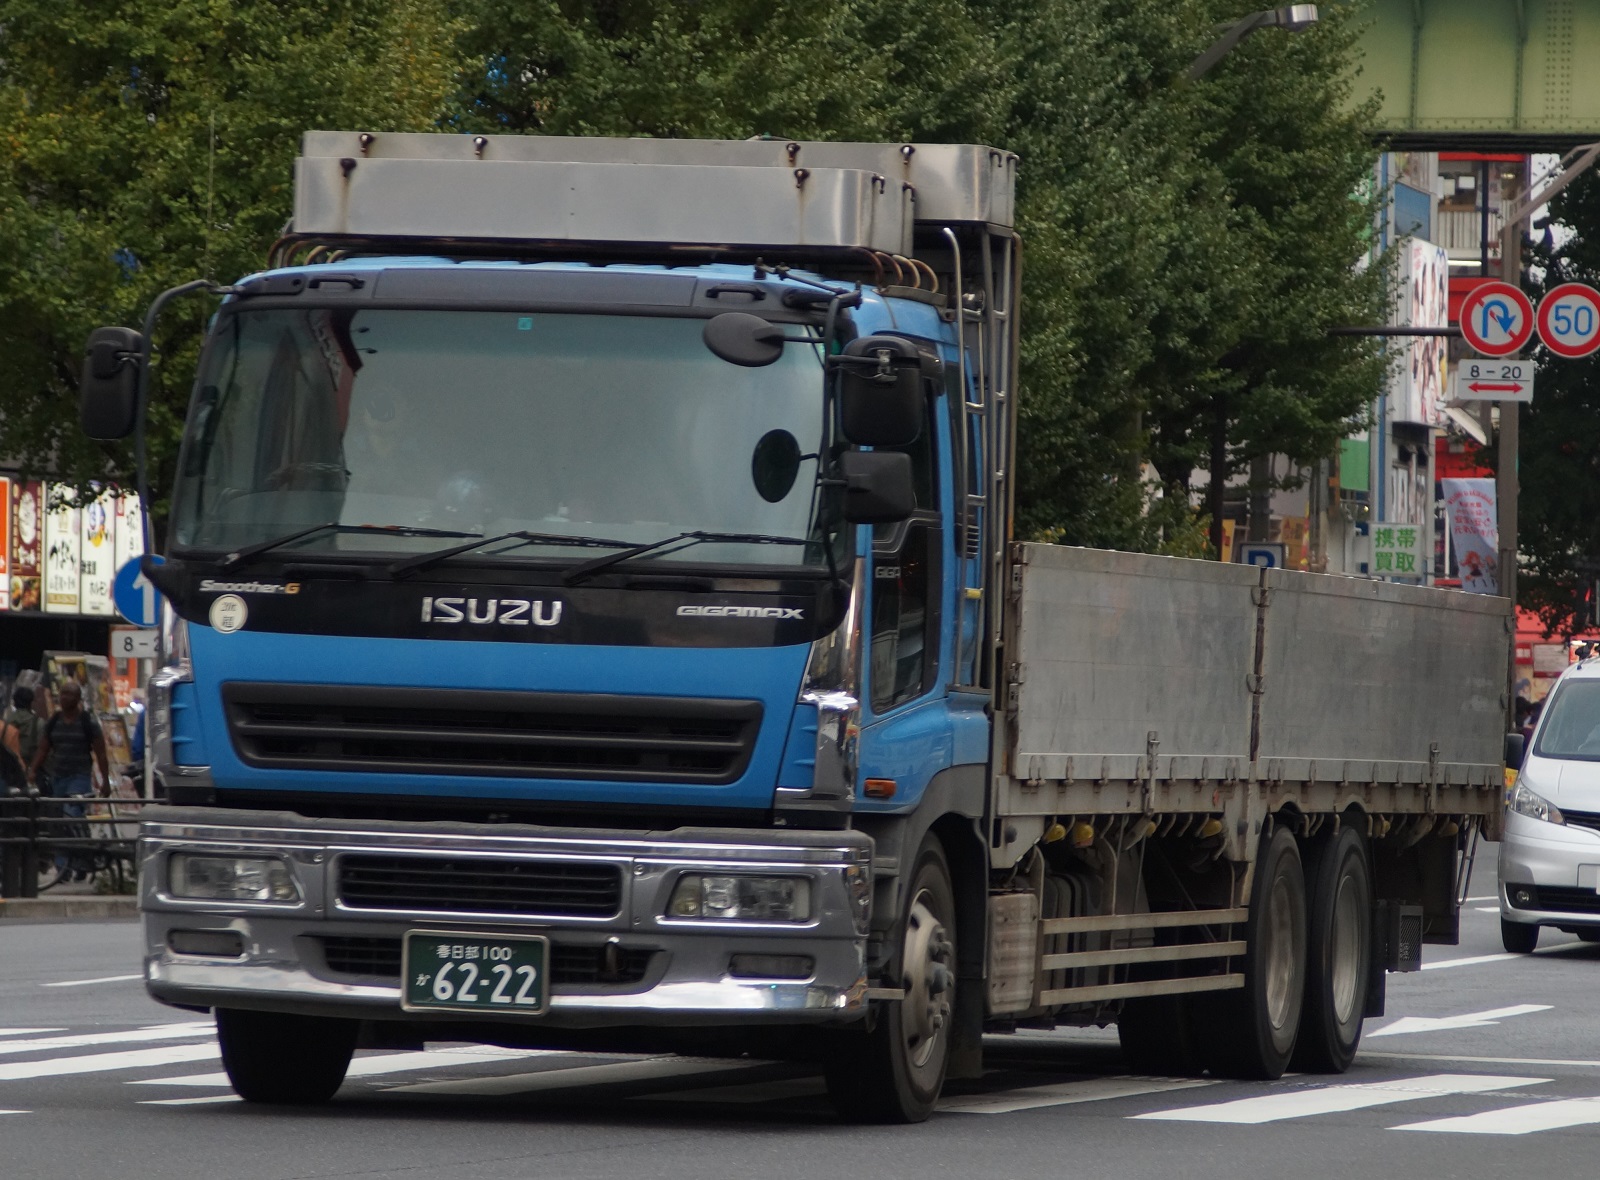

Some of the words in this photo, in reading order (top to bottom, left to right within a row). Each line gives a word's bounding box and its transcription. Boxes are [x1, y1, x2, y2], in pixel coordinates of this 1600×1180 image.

[1554, 304, 1593, 336] 50
[1374, 527, 1416, 549] 携帯
[1248, 549, 1275, 568] P
[1374, 551, 1416, 573] 買取
[199, 579, 301, 595] Smoother-G
[420, 596, 563, 626] ISUZU
[676, 605, 804, 620] GIGAMAX
[432, 961, 537, 1005] 62-22
